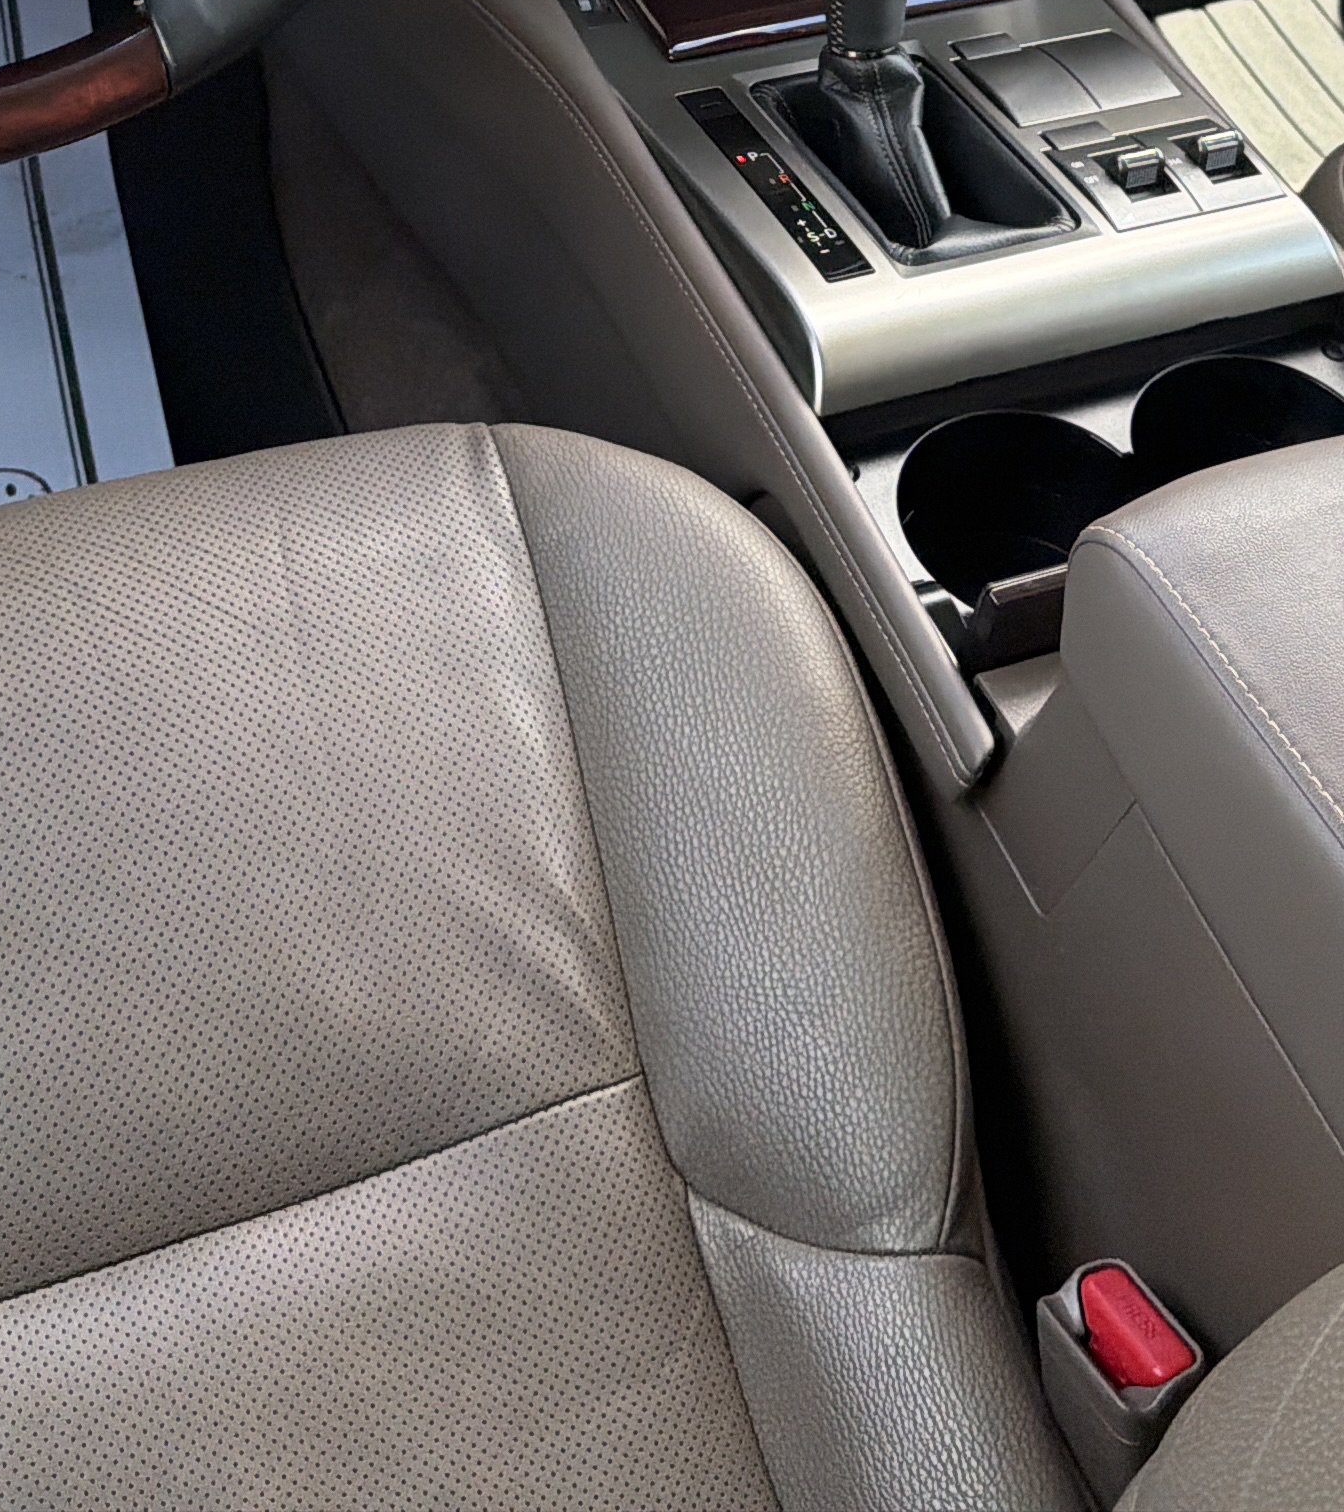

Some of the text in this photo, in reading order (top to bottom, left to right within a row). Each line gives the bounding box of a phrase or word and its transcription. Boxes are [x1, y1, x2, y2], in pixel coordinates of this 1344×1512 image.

[747, 152, 758, 162] P
[778, 174, 791, 185] R
[801, 201, 815, 211] N
[807, 228, 838, 243] S D
